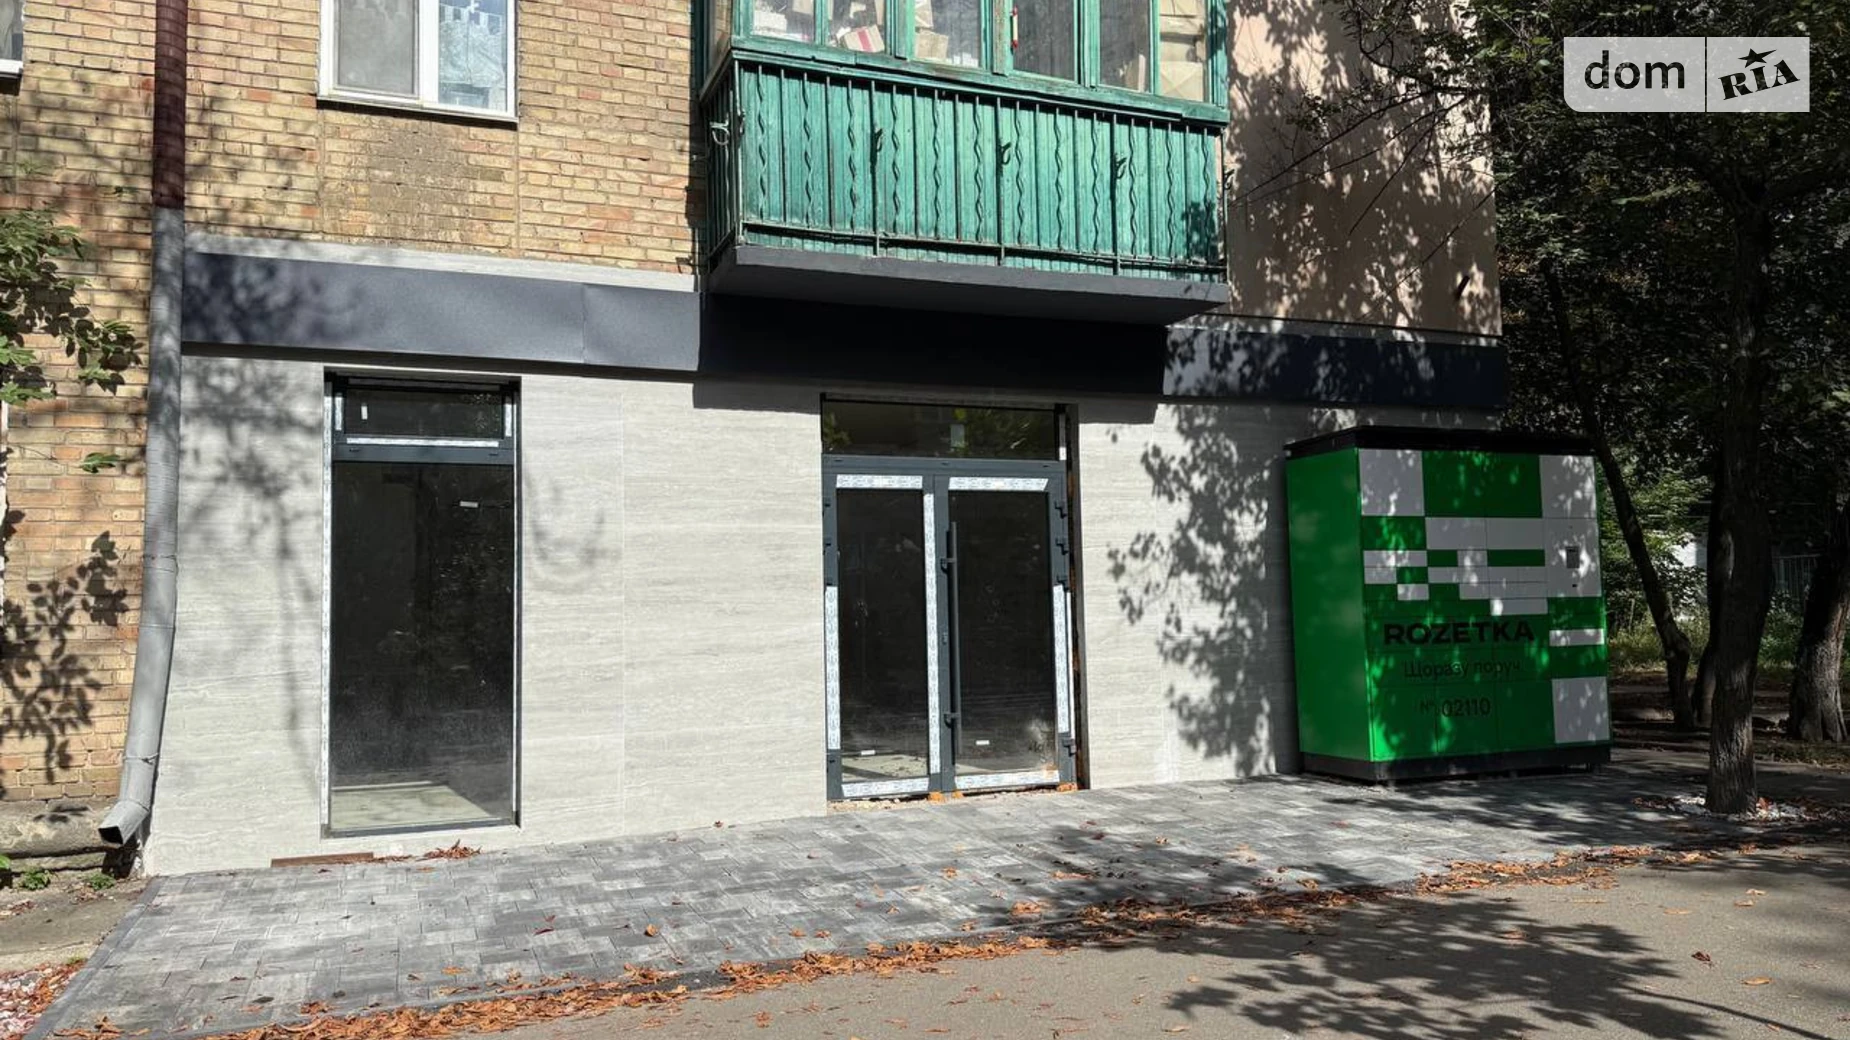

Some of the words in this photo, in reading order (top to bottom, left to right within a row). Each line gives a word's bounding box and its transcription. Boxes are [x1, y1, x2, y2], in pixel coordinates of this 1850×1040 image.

[1384, 621, 1534, 645] ROZETKA
[1404, 661, 1469, 679] Щоразу
[1474, 661, 1521, 676] поруч
[1442, 697, 1491, 718] 02110
